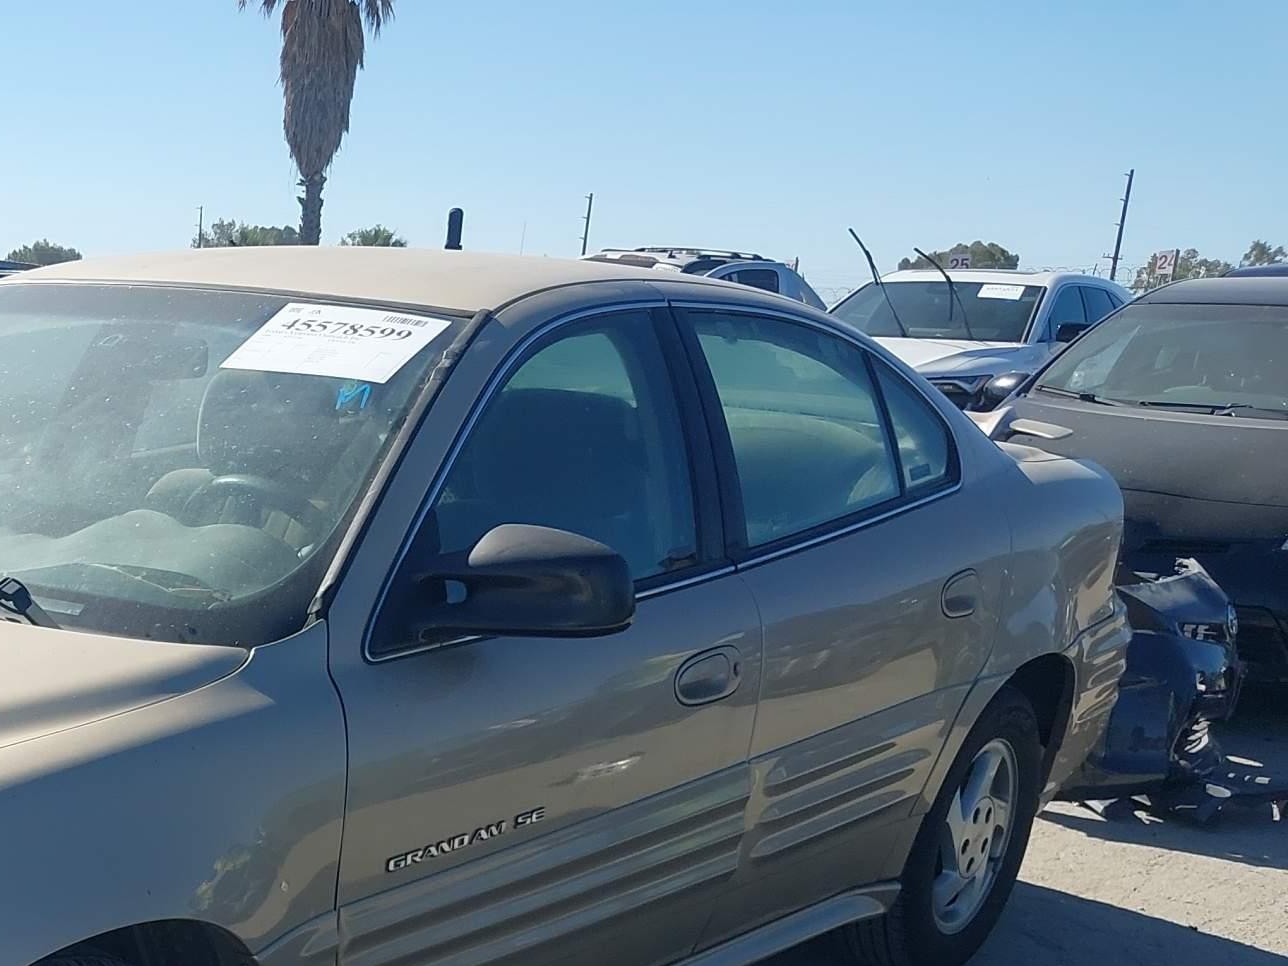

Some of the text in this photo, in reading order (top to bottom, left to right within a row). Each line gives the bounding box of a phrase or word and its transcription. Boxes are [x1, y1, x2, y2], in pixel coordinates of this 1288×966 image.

[281, 317, 412, 341] 45578599
[385, 806, 547, 873] GRAND AM SE
